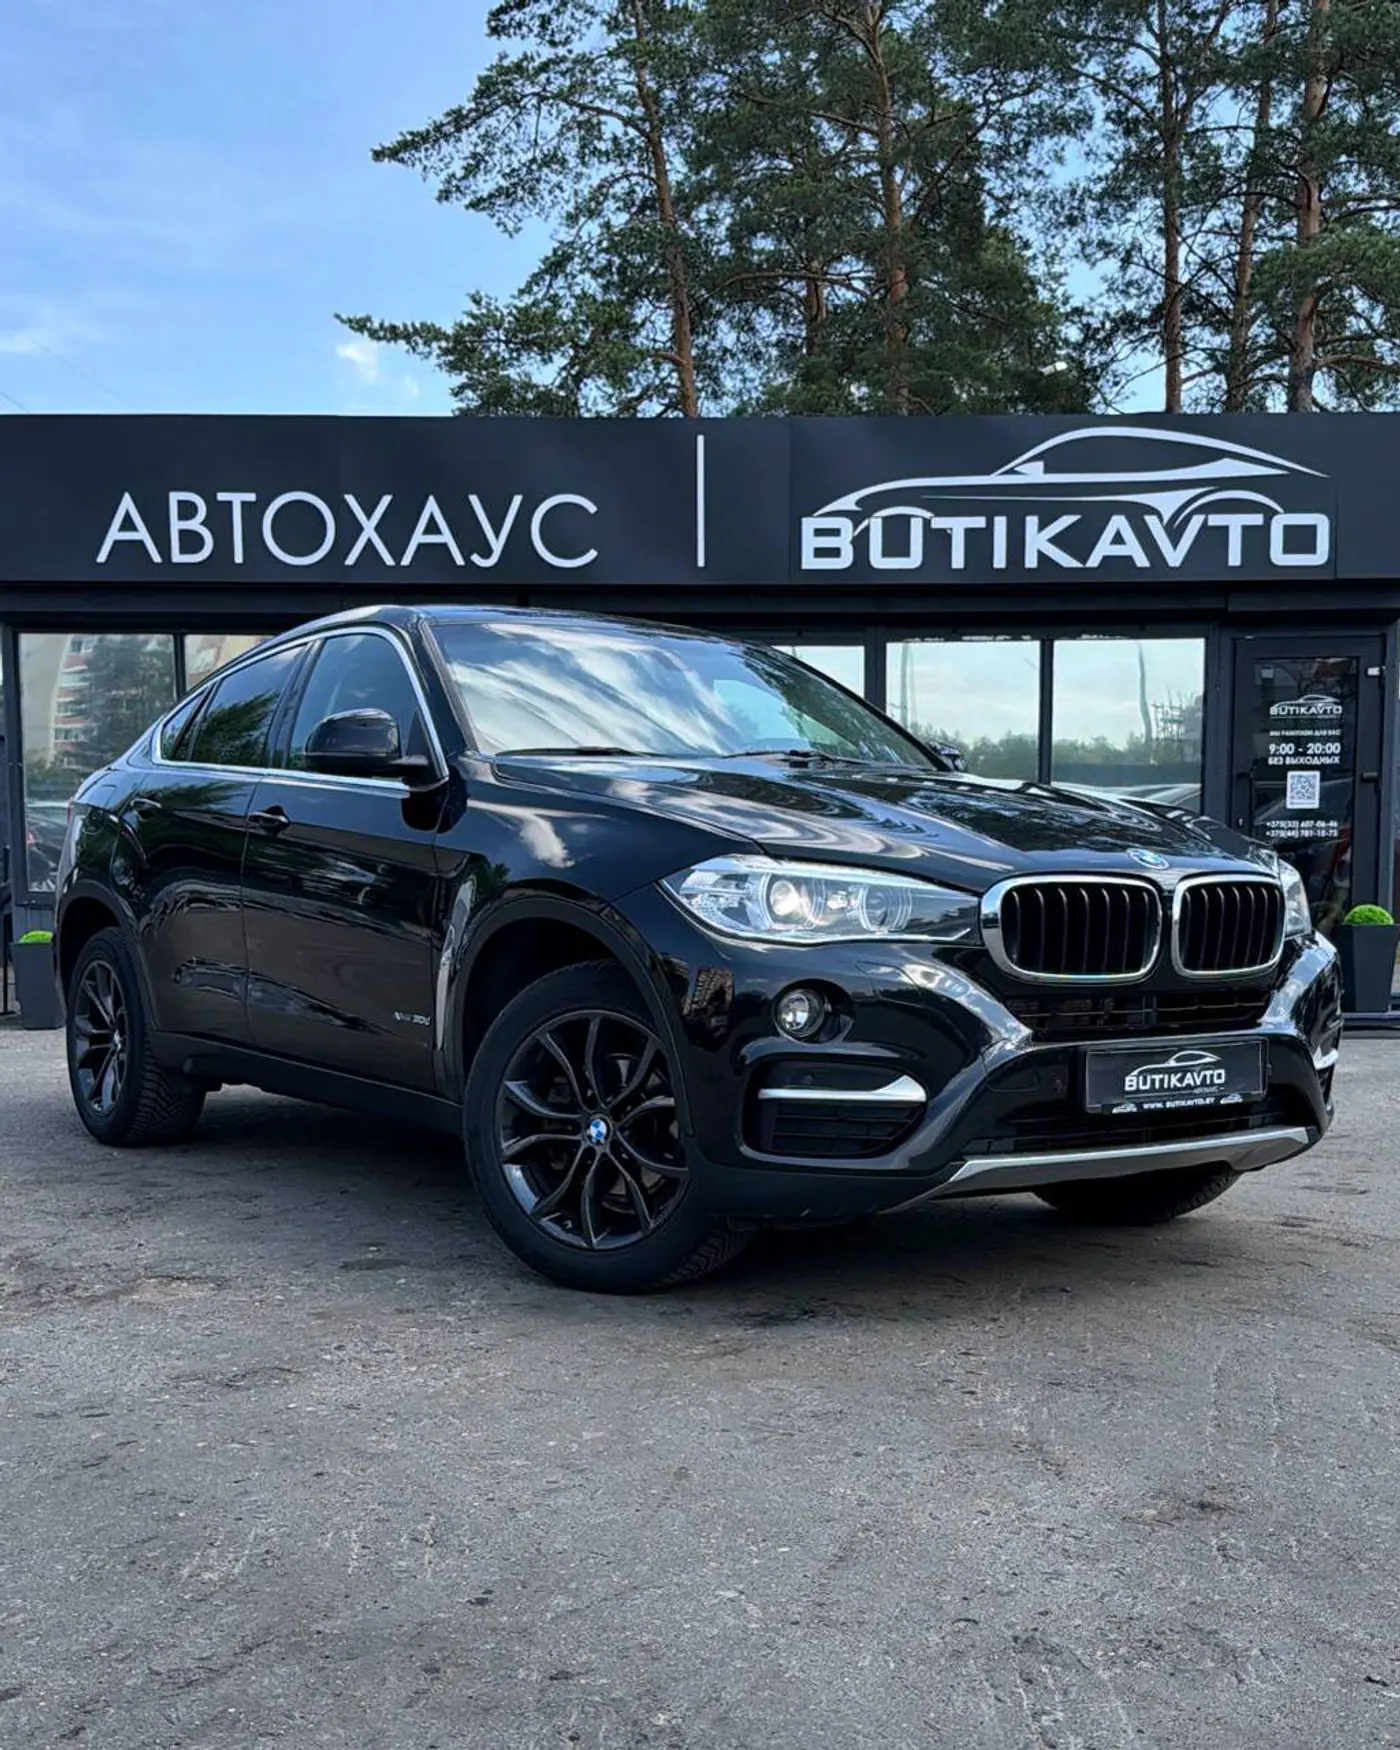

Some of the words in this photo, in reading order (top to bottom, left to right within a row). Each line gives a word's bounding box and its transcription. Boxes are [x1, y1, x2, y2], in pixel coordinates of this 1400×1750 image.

[96, 491, 600, 568] АВТОХАУС
[801, 512, 1331, 570] BUTIKAVTO
[1269, 705, 1343, 715] BUTIKAVTO
[1268, 743, 1295, 755] 9:00
[1306, 742, 1341, 755] 20:00
[1268, 756, 1284, 766] БЕЗ
[1285, 755, 1341, 766] ВЫХОДНЫХ
[1124, 1069, 1226, 1091] BUTIKAVTO
